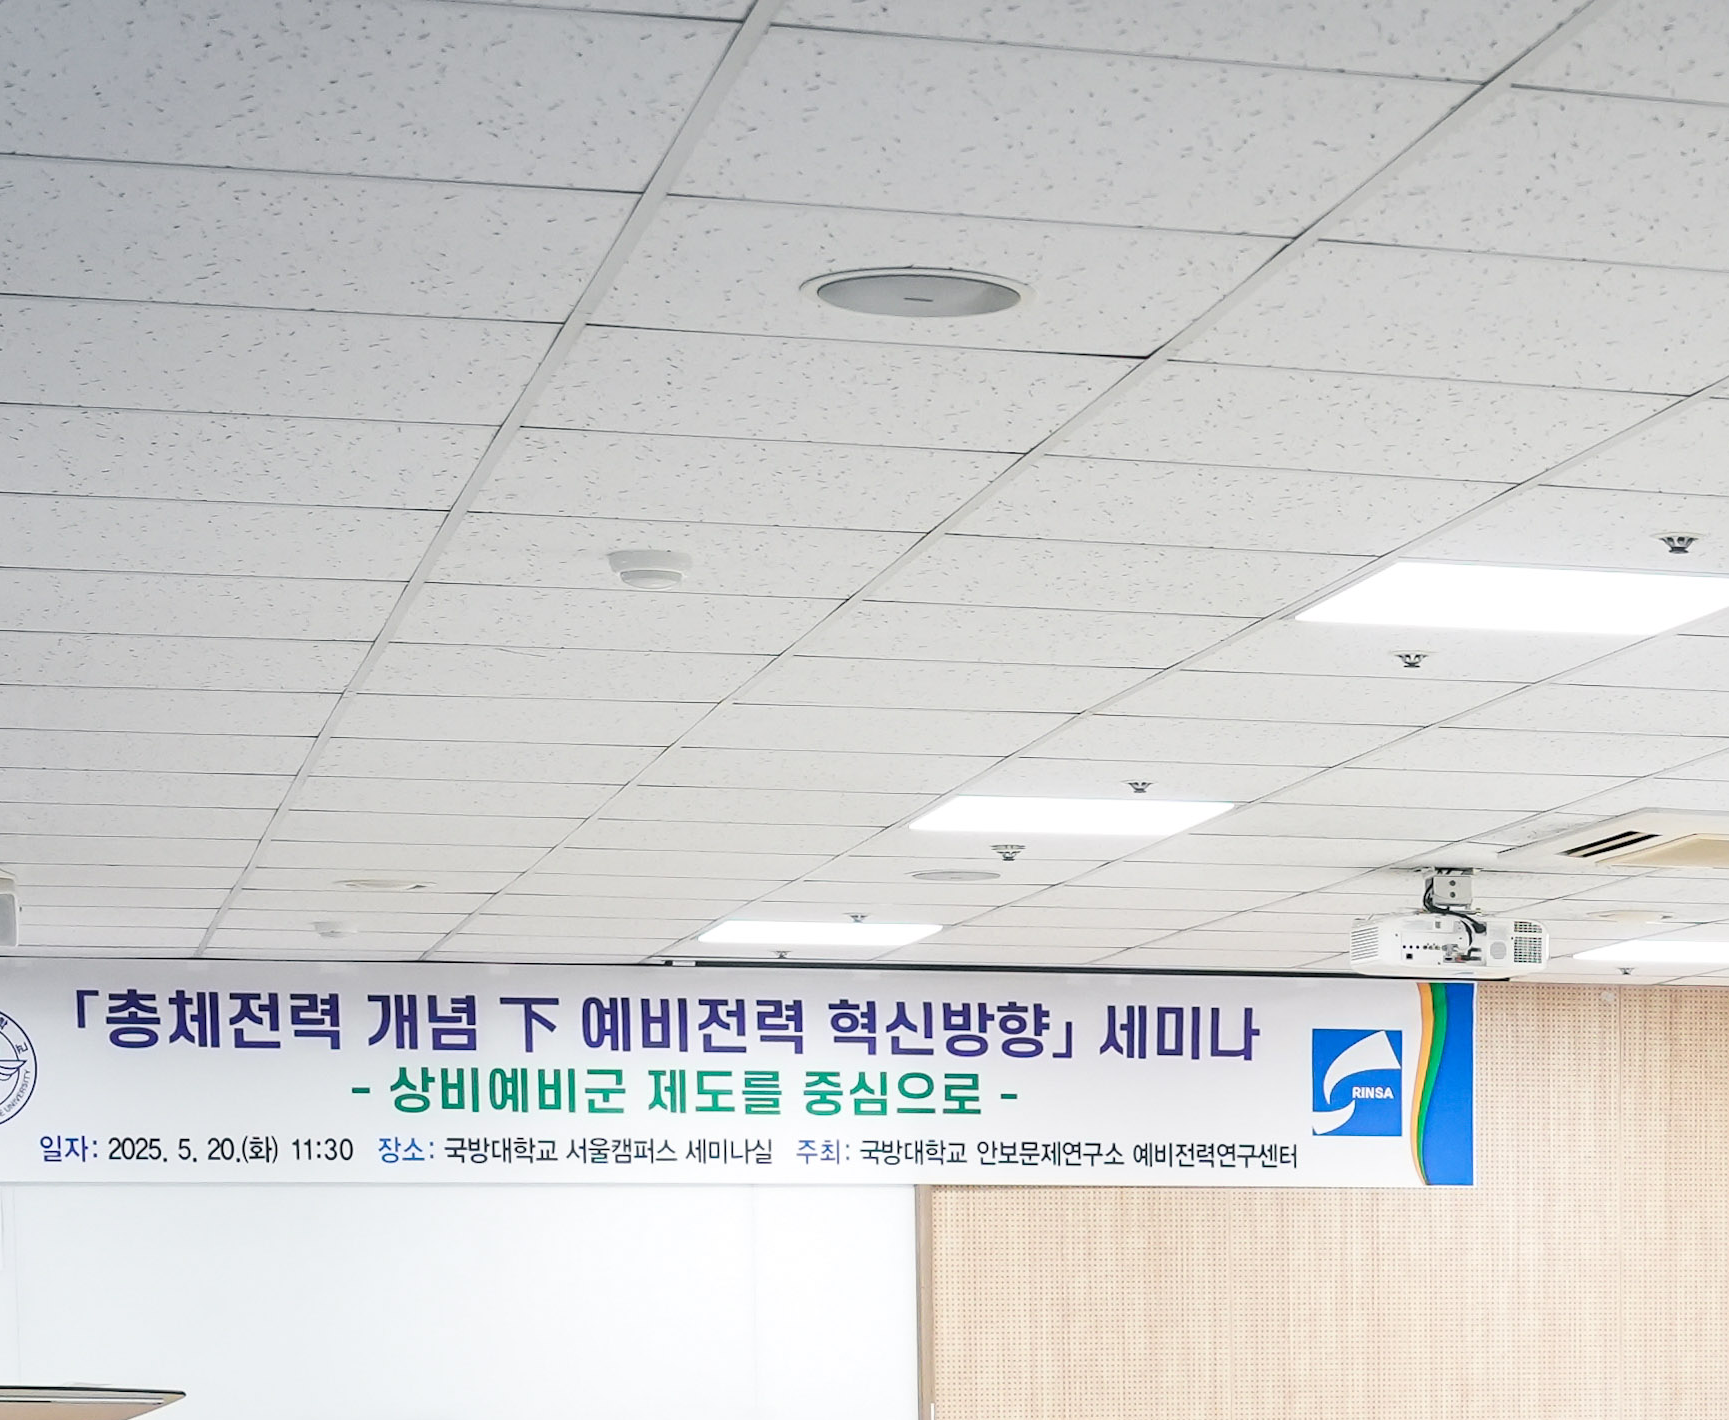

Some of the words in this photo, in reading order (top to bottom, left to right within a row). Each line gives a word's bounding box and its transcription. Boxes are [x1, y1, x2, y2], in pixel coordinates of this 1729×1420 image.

[368, 994, 479, 1051] 개념
[499, 997, 561, 1053] 下
[581, 996, 804, 1055] 예비전력
[1099, 1005, 1261, 1062] 세미나
[4, 1069, 32, 1113] UNIVERSITY
[389, 1066, 626, 1114] 상비예비군
[647, 1069, 782, 1115] 제도를
[803, 1070, 982, 1116] 중심으로
[1351, 1086, 1394, 1100] RINSA
[40, 1135, 98, 1163] 일자:
[108, 1137, 168, 1163] 2025.
[291, 1137, 354, 1163] 11:30
[378, 1136, 435, 1164] 장소:
[445, 1136, 559, 1165] 국방대학교
[566, 1138, 678, 1165] 서울캠퍼스
[685, 1138, 773, 1165] 세미나실
[796, 1139, 851, 1165] 주최:
[859, 1139, 968, 1166] 국방대학교
[976, 1140, 1126, 1167] 안보문제연구소
[1133, 1142, 1298, 1169] 예비전력연구센터
